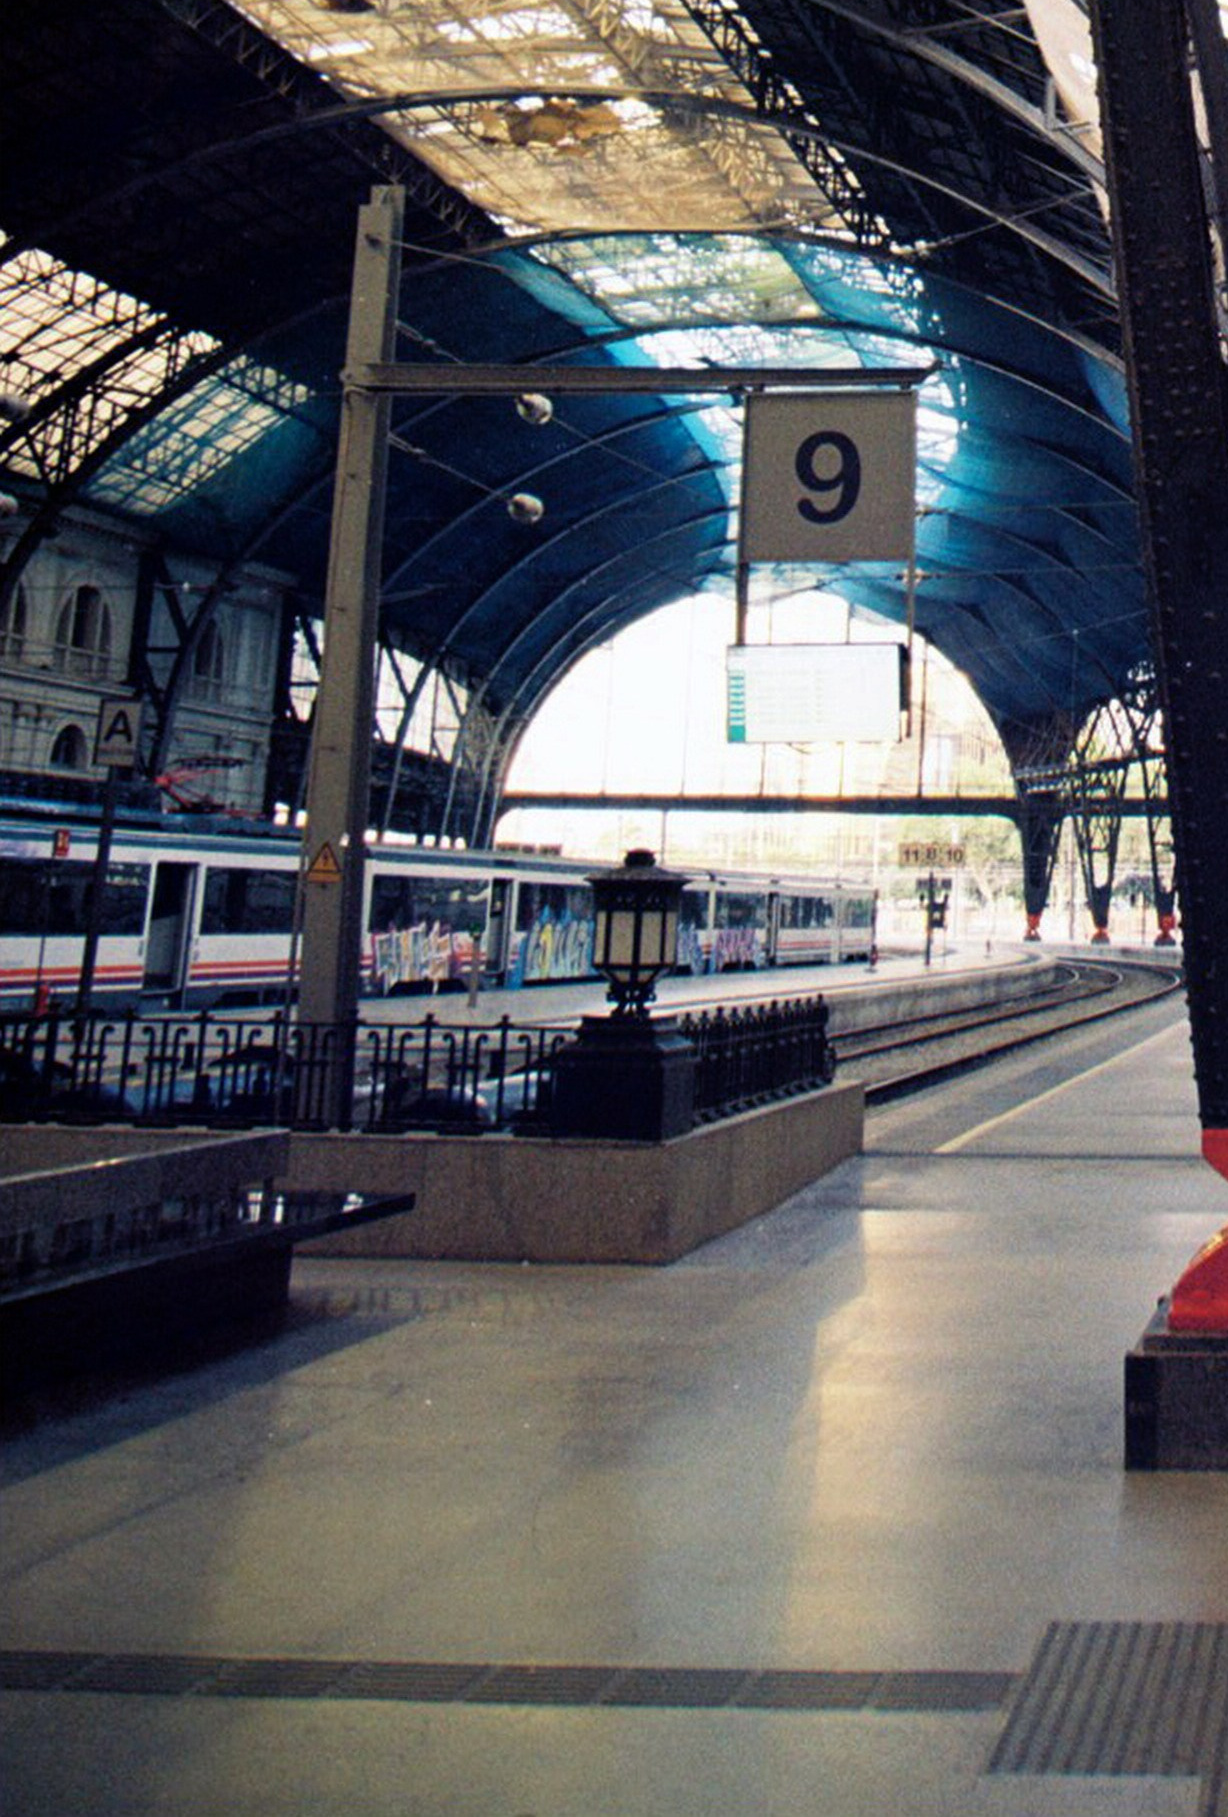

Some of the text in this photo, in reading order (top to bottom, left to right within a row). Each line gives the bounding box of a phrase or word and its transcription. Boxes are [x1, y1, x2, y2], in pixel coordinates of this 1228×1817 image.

[795, 430, 861, 524] 9
[104, 708, 132, 743] A
[904, 847, 963, 863] 11 10
